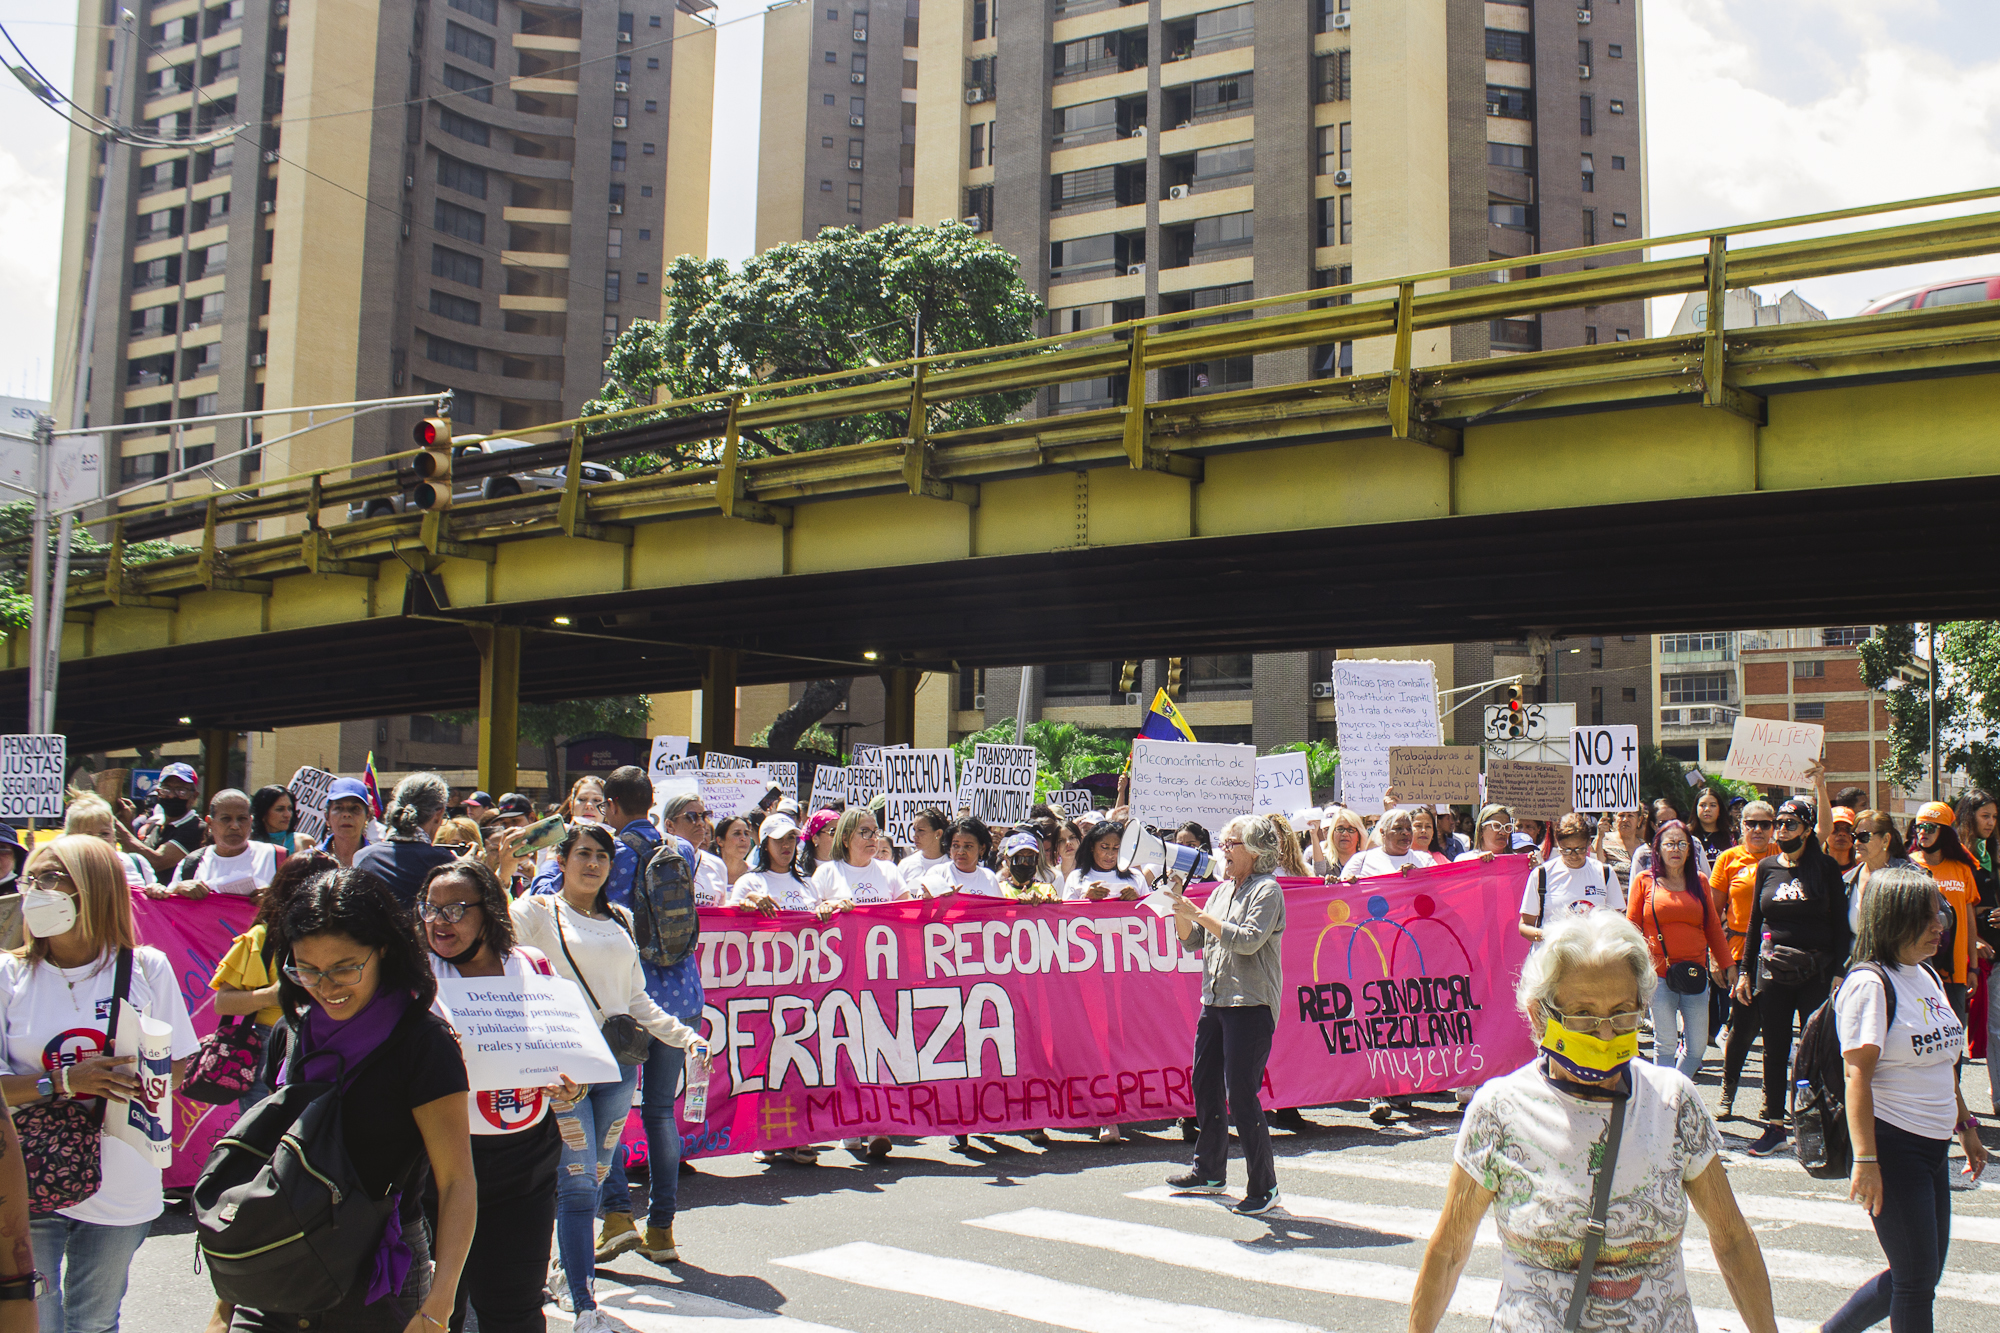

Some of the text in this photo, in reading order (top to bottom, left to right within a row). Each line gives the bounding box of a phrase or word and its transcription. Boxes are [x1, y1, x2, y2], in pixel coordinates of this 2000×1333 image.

[1347, 703, 1356, 714] la
[1359, 704, 1381, 714] trata
[1751, 723, 1816, 747] MUJER
[4, 737, 62, 754] PENSIONES
[1575, 730, 1613, 766] NO
[3, 756, 62, 774] JUSTAS
[977, 747, 1033, 767] TRANSPORTE
[1230, 755, 1244, 768] de
[1391, 748, 1459, 766] Trabajadoras
[1464, 749, 1474, 760] de
[769, 764, 796, 775] PUEBLO
[847, 768, 884, 787] DERECH
[886, 754, 940, 793] DERECHO
[943, 754, 952, 792] A
[1134, 767, 1151, 783] las
[1155, 773, 1188, 786] tareas
[1194, 775, 1207, 786] de
[1395, 763, 1443, 775] Nutrición
[2, 777, 61, 795] SEGURIDAD
[1392, 777, 1406, 787] En
[1430, 777, 1461, 788] Lucha
[1575, 765, 1637, 808] REPRESIÓN
[847, 788, 860, 805] LA
[1048, 791, 1090, 803] VIDA
[1132, 788, 1149, 799] que
[1153, 788, 1196, 801] cumplan
[1200, 789, 1216, 800] las
[1260, 794, 1272, 806] de
[1, 797, 60, 815] SOCIAL
[888, 800, 900, 821] LA
[974, 788, 1030, 823] COMBUSTIBLE
[1130, 804, 1136, 815] y
[1140, 804, 1156, 816] que
[865, 925, 899, 981] A
[466, 991, 555, 1002] Defendemos:
[1297, 974, 1482, 1023] RED SINDICAL
[452, 1008, 492, 1017] Salario
[531, 1008, 580, 1019] pensiones
[468, 1025, 475, 1035] y
[477, 1023, 543, 1035] jubilaciones
[1319, 1012, 1474, 1055] VENEZOLANA
[1911, 1028, 1942, 1048] Red
[477, 1039, 583, 1052] reales y suficientes
